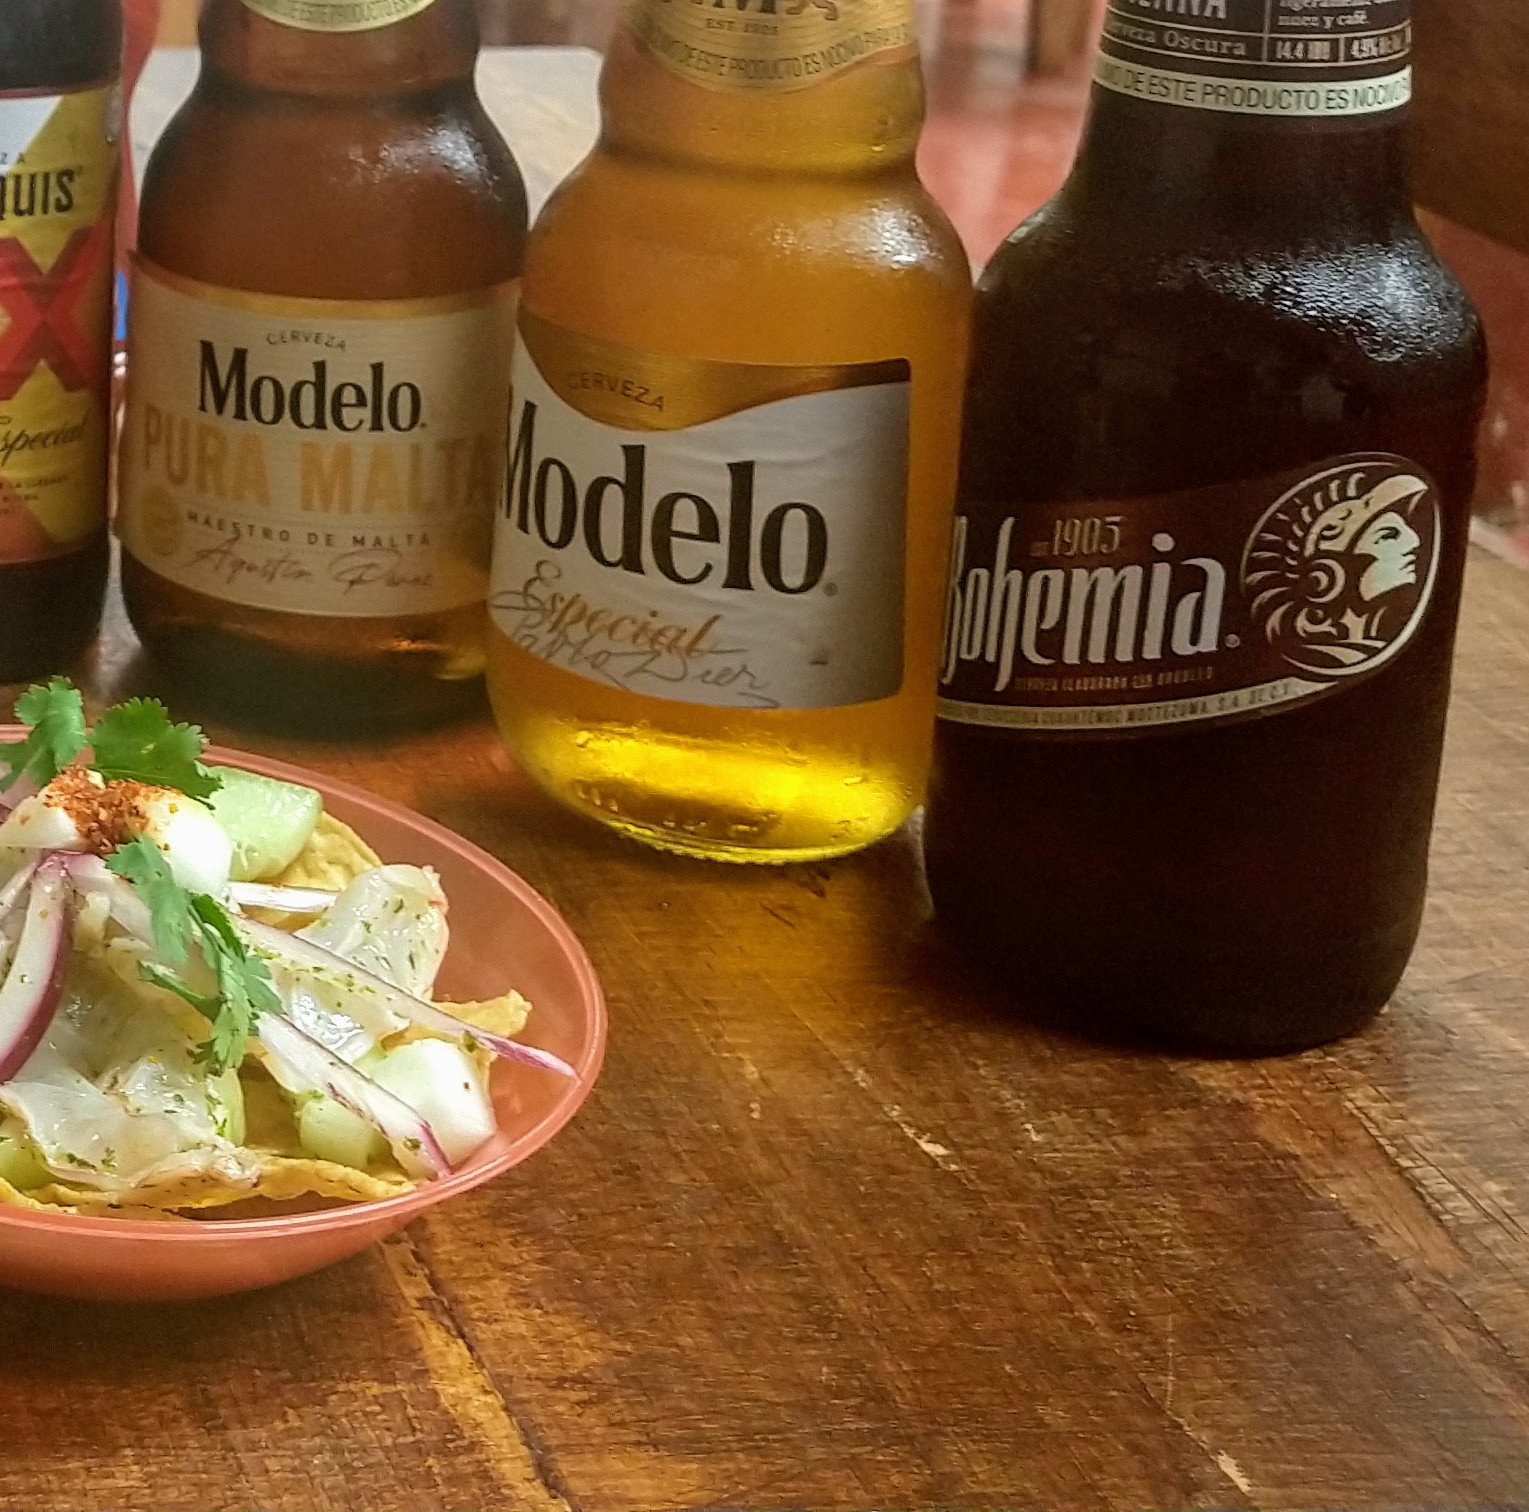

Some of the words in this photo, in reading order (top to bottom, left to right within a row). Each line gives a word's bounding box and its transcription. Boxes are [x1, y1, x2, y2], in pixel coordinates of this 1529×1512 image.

[1163, 30, 1248, 57] Oscura
[1148, 75, 1194, 101] ESTE
[1202, 84, 1320, 110] PRODUCTO
[1325, 88, 1349, 110] ES
[266, 329, 347, 352] CERVEZA
[197, 339, 423, 434] Modelo
[569, 372, 666, 413] CERVEZA
[143, 403, 271, 506] PURA
[500, 384, 830, 596] Modelo
[186, 510, 291, 542] MAESTRO
[306, 532, 335, 548] DE
[351, 532, 432, 548] MALTA
[1052, 515, 1124, 557] 1905
